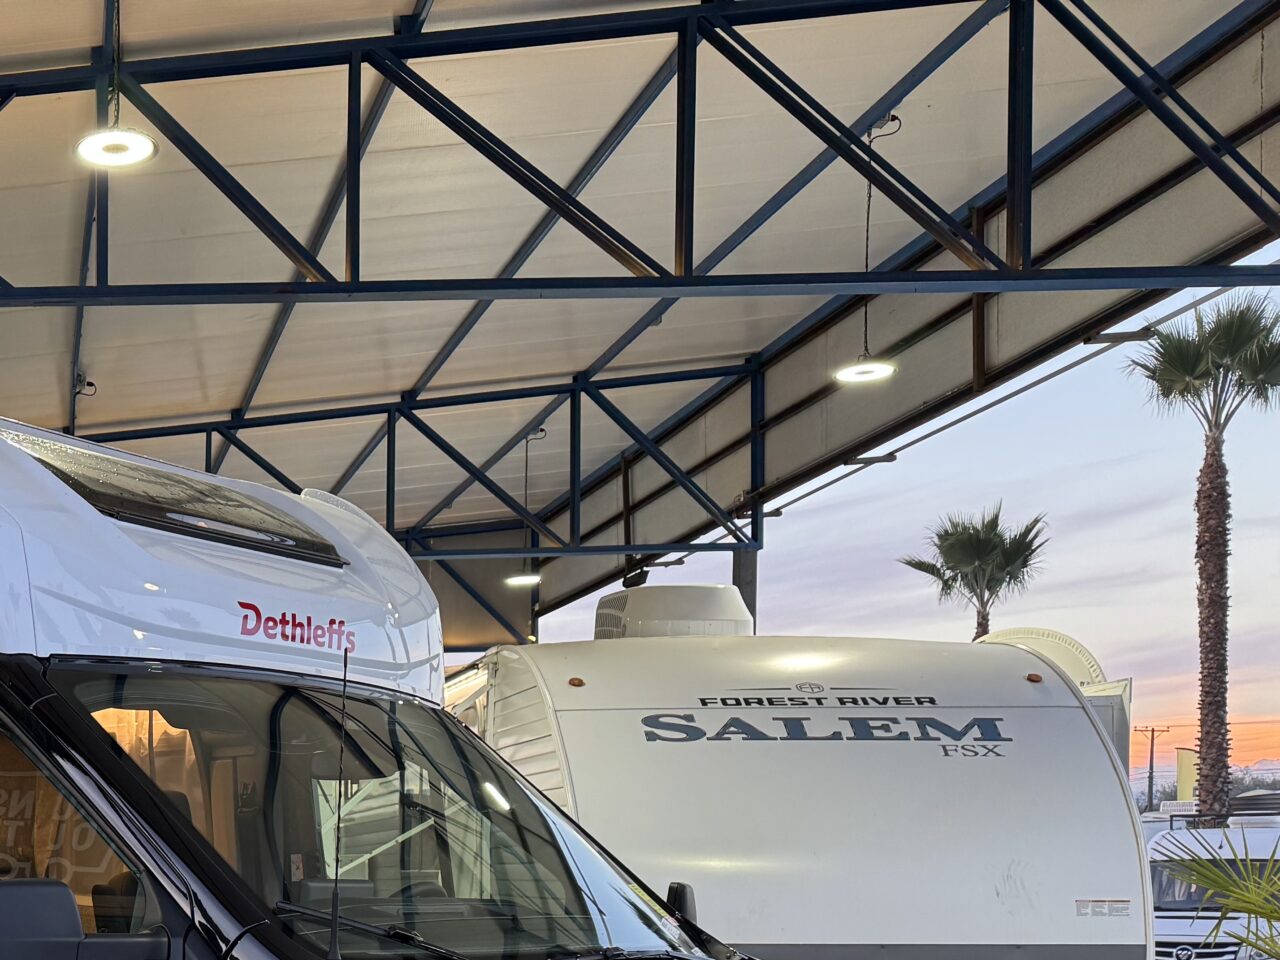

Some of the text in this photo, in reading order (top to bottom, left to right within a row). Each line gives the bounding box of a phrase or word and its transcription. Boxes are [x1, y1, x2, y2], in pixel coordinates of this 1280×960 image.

[237, 601, 356, 654] Dethleffs
[698, 696, 939, 706] FOREST RIVER
[641, 713, 1013, 742] SALEM
[939, 744, 1006, 757] FSX
